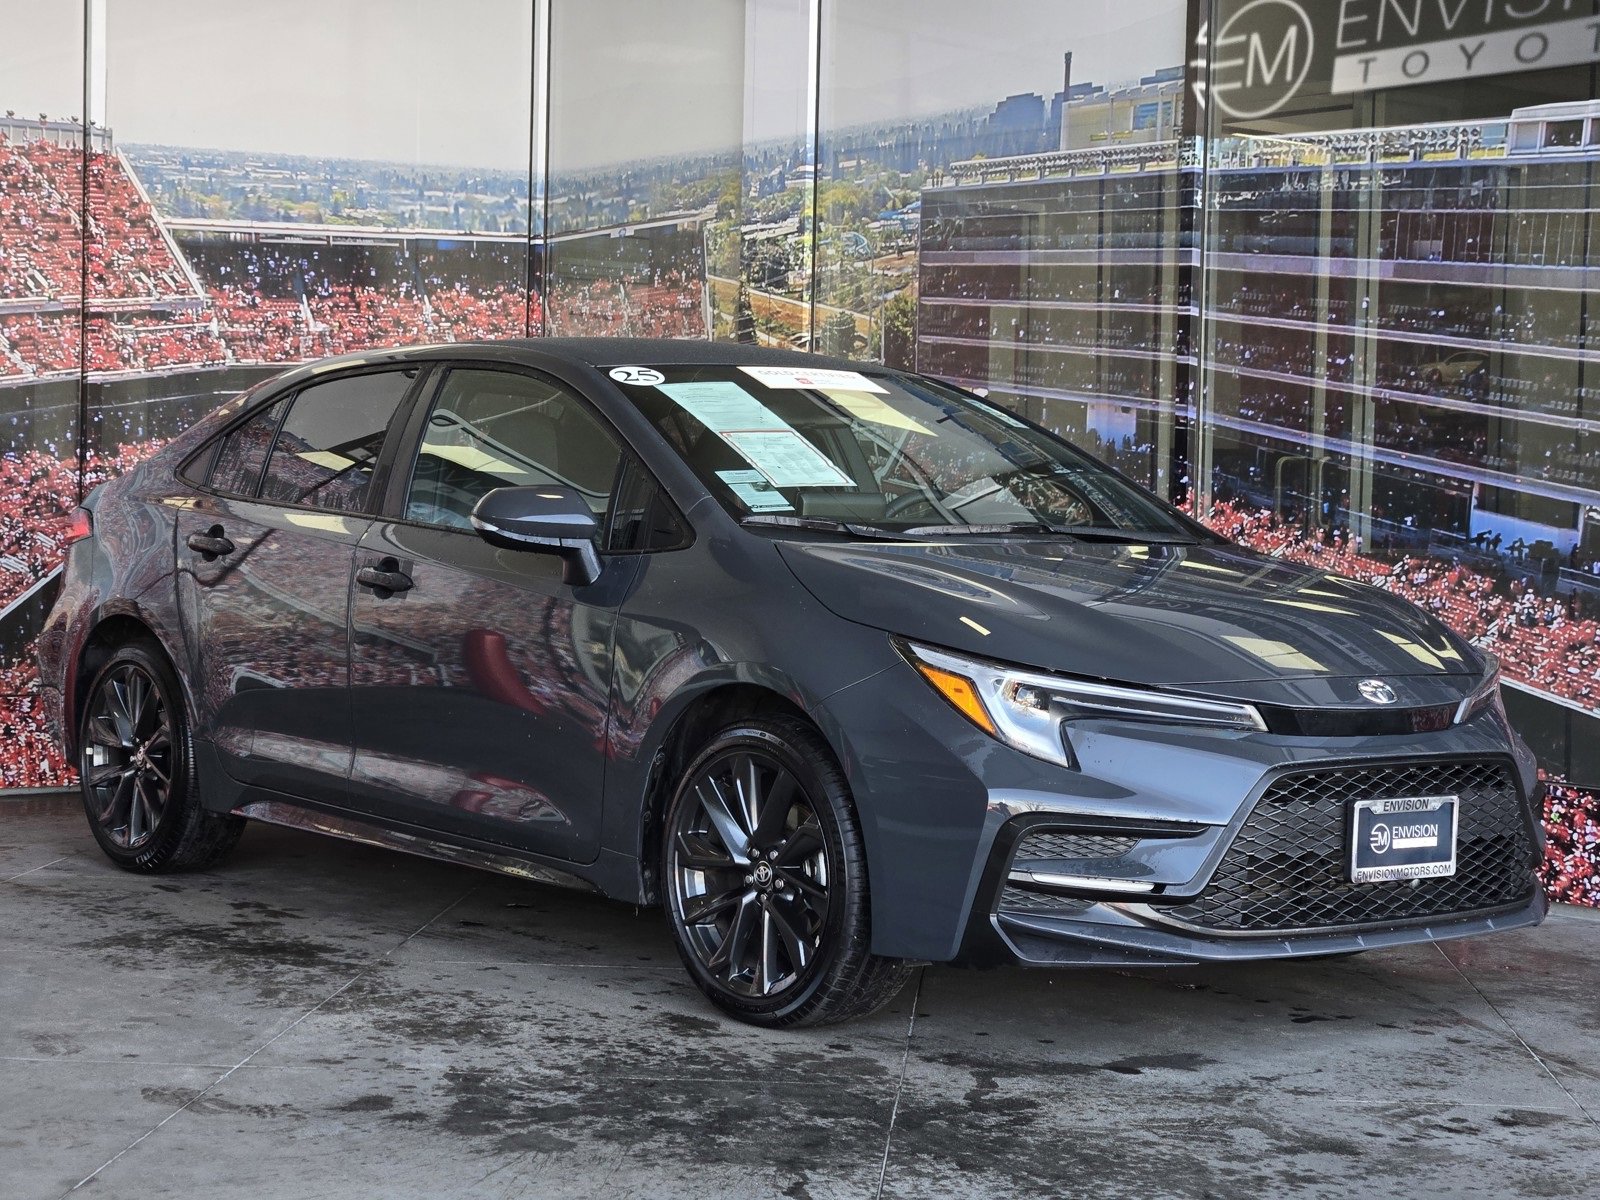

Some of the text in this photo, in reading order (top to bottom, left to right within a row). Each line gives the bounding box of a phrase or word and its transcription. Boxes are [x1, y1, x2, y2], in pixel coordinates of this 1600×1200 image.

[614, 370, 659, 381] 25
[1383, 799, 1430, 812] ENVISION
[1392, 824, 1438, 839] ENVISION
[1357, 864, 1451, 880] ENVISIONMOTORS.COM
